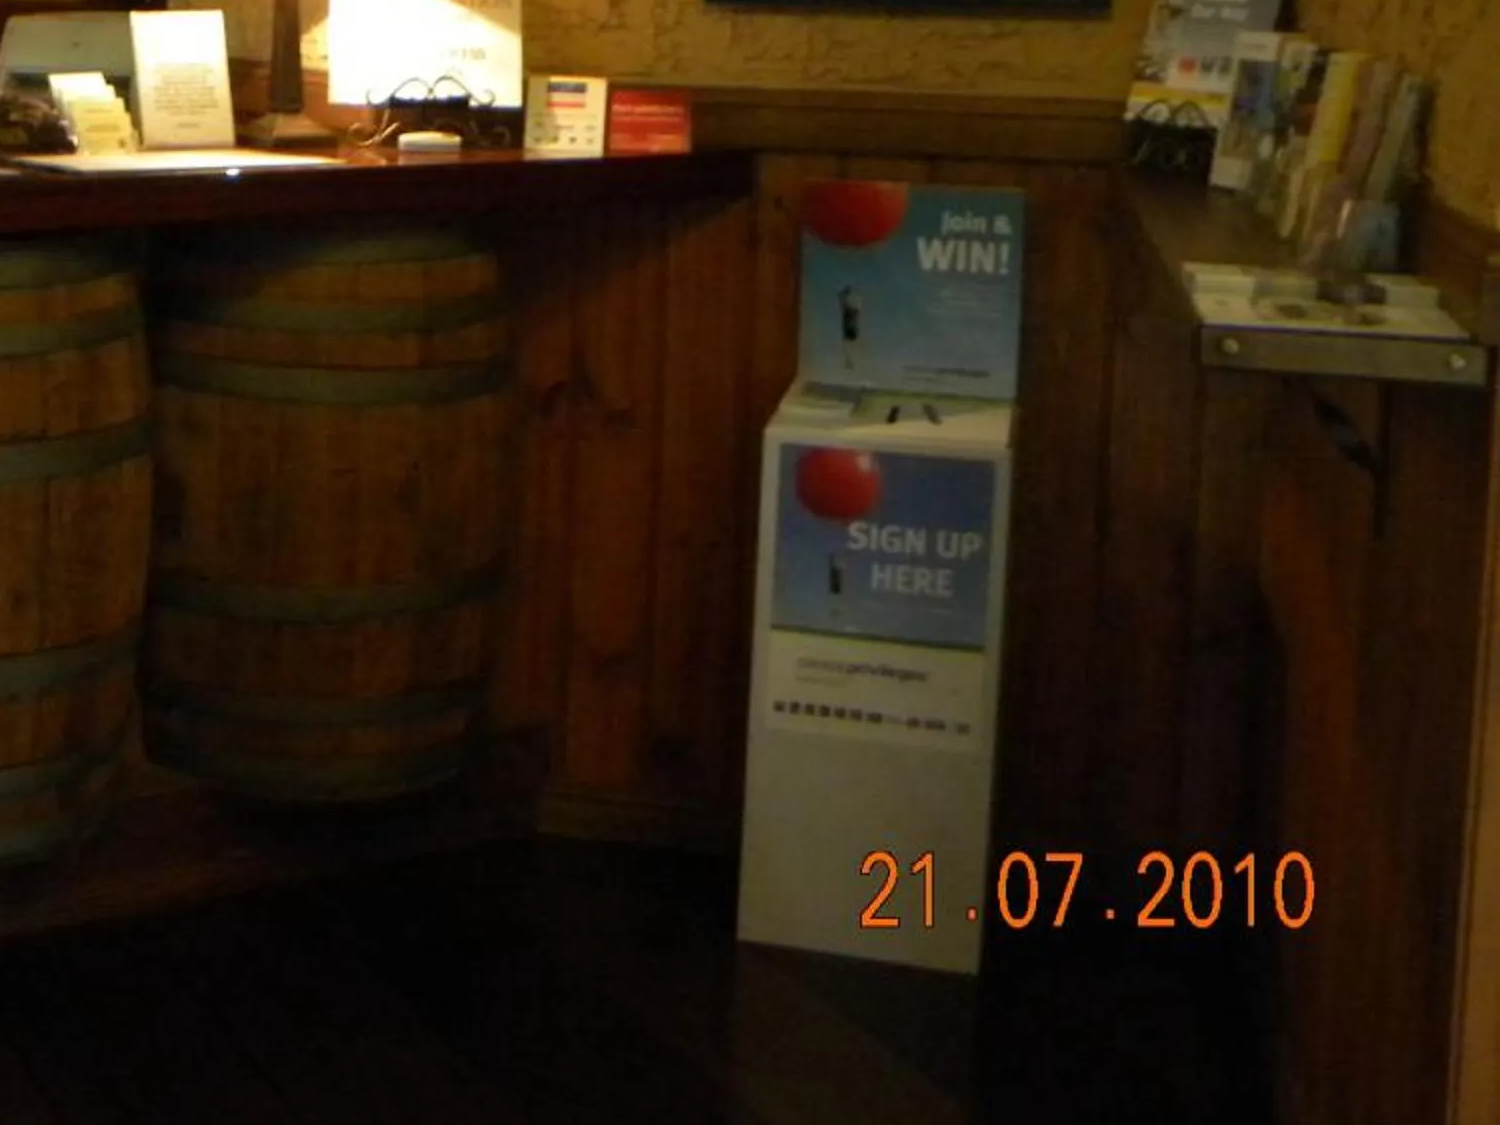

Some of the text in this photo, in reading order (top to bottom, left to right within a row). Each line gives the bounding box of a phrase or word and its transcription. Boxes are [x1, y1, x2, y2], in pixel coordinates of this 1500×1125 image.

[916, 236, 1010, 275] WIN!
[846, 520, 982, 560] SIGN UP
[870, 562, 954, 596] HERE
